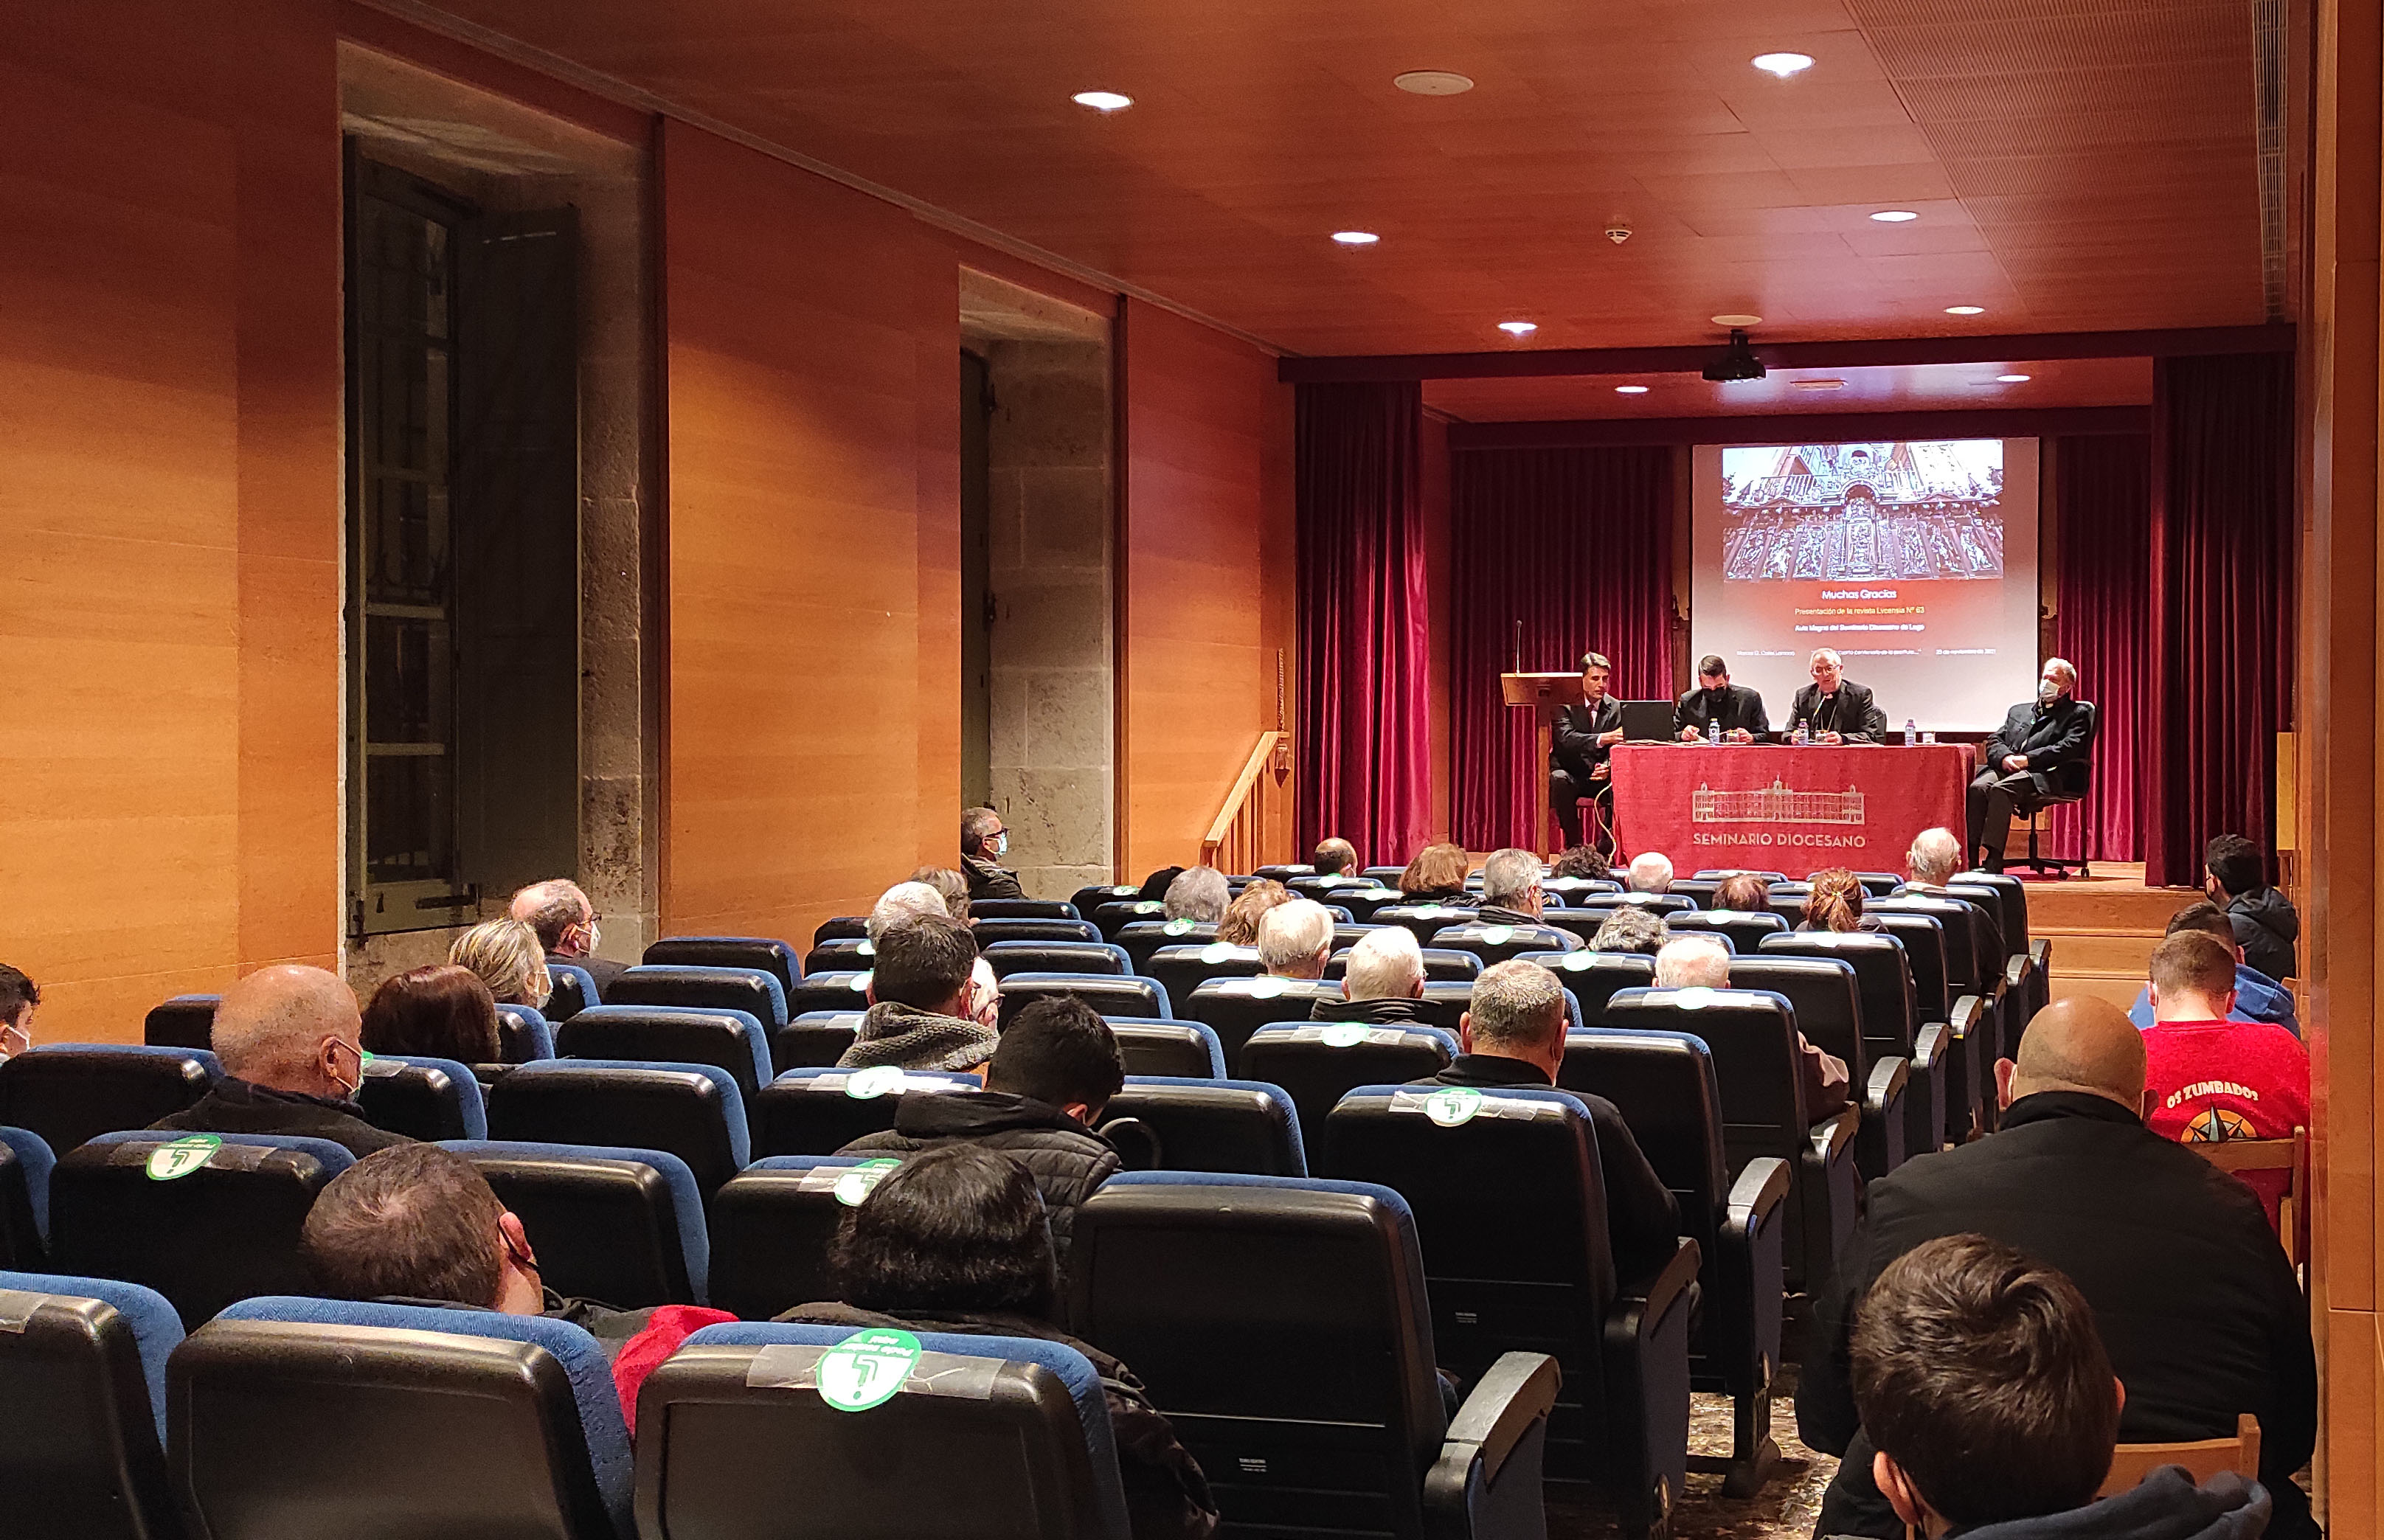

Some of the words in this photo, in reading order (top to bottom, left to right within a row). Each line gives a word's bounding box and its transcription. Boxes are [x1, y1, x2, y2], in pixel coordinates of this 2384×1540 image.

[1822, 590, 1859, 599] Muchas
[1860, 589, 1896, 598] Gracias
[1693, 833, 1773, 845] SEMINARIO
[1777, 833, 1866, 847] DIOCESANO
[2166, 1090, 2182, 1109] OS
[2183, 1081, 2259, 1101] ZUMBADOS
